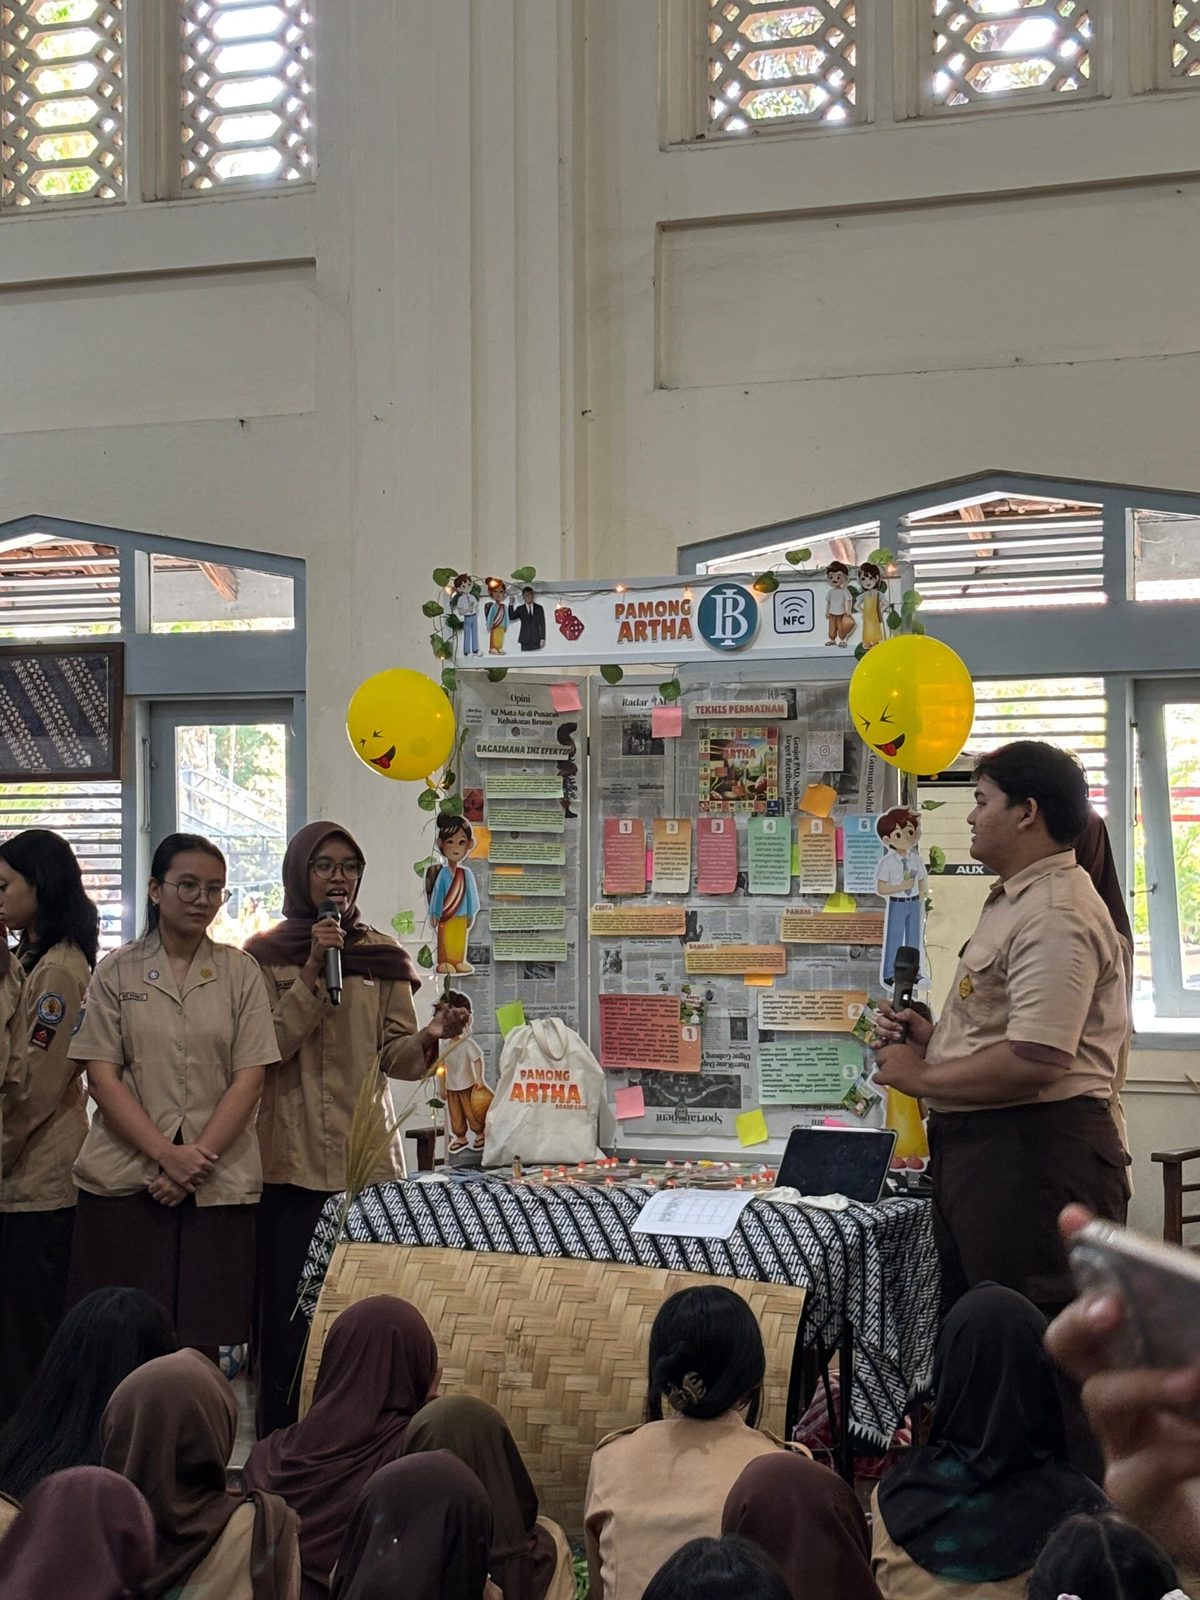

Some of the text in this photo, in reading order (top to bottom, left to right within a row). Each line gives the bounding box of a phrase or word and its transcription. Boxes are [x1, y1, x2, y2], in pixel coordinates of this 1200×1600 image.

[615, 599, 692, 619] PAMONG
[783, 615, 805, 626] NFC
[617, 617, 693, 643] ARTHA
[511, 694, 530, 704] Opini
[622, 698, 649, 707] Radar
[500, 709, 517, 717] Mata
[527, 709, 533, 717] di
[534, 710, 560, 718] Pusaran
[695, 704, 785, 714] TEKNIS PERMAINAN
[477, 745, 525, 754] BAGAIMANA
[527, 746, 541, 754] INI
[865, 755, 877, 813] Gunungkidul
[623, 823, 629, 831] 1
[714, 822, 721, 831] 3
[861, 820, 868, 829] 6
[956, 866, 984, 874] AUX
[687, 1028, 693, 1040] 1
[520, 1069, 570, 1081] PAMONG
[510, 1083, 581, 1104] ARTHA
[656, 1112, 723, 1125] Sportaient
